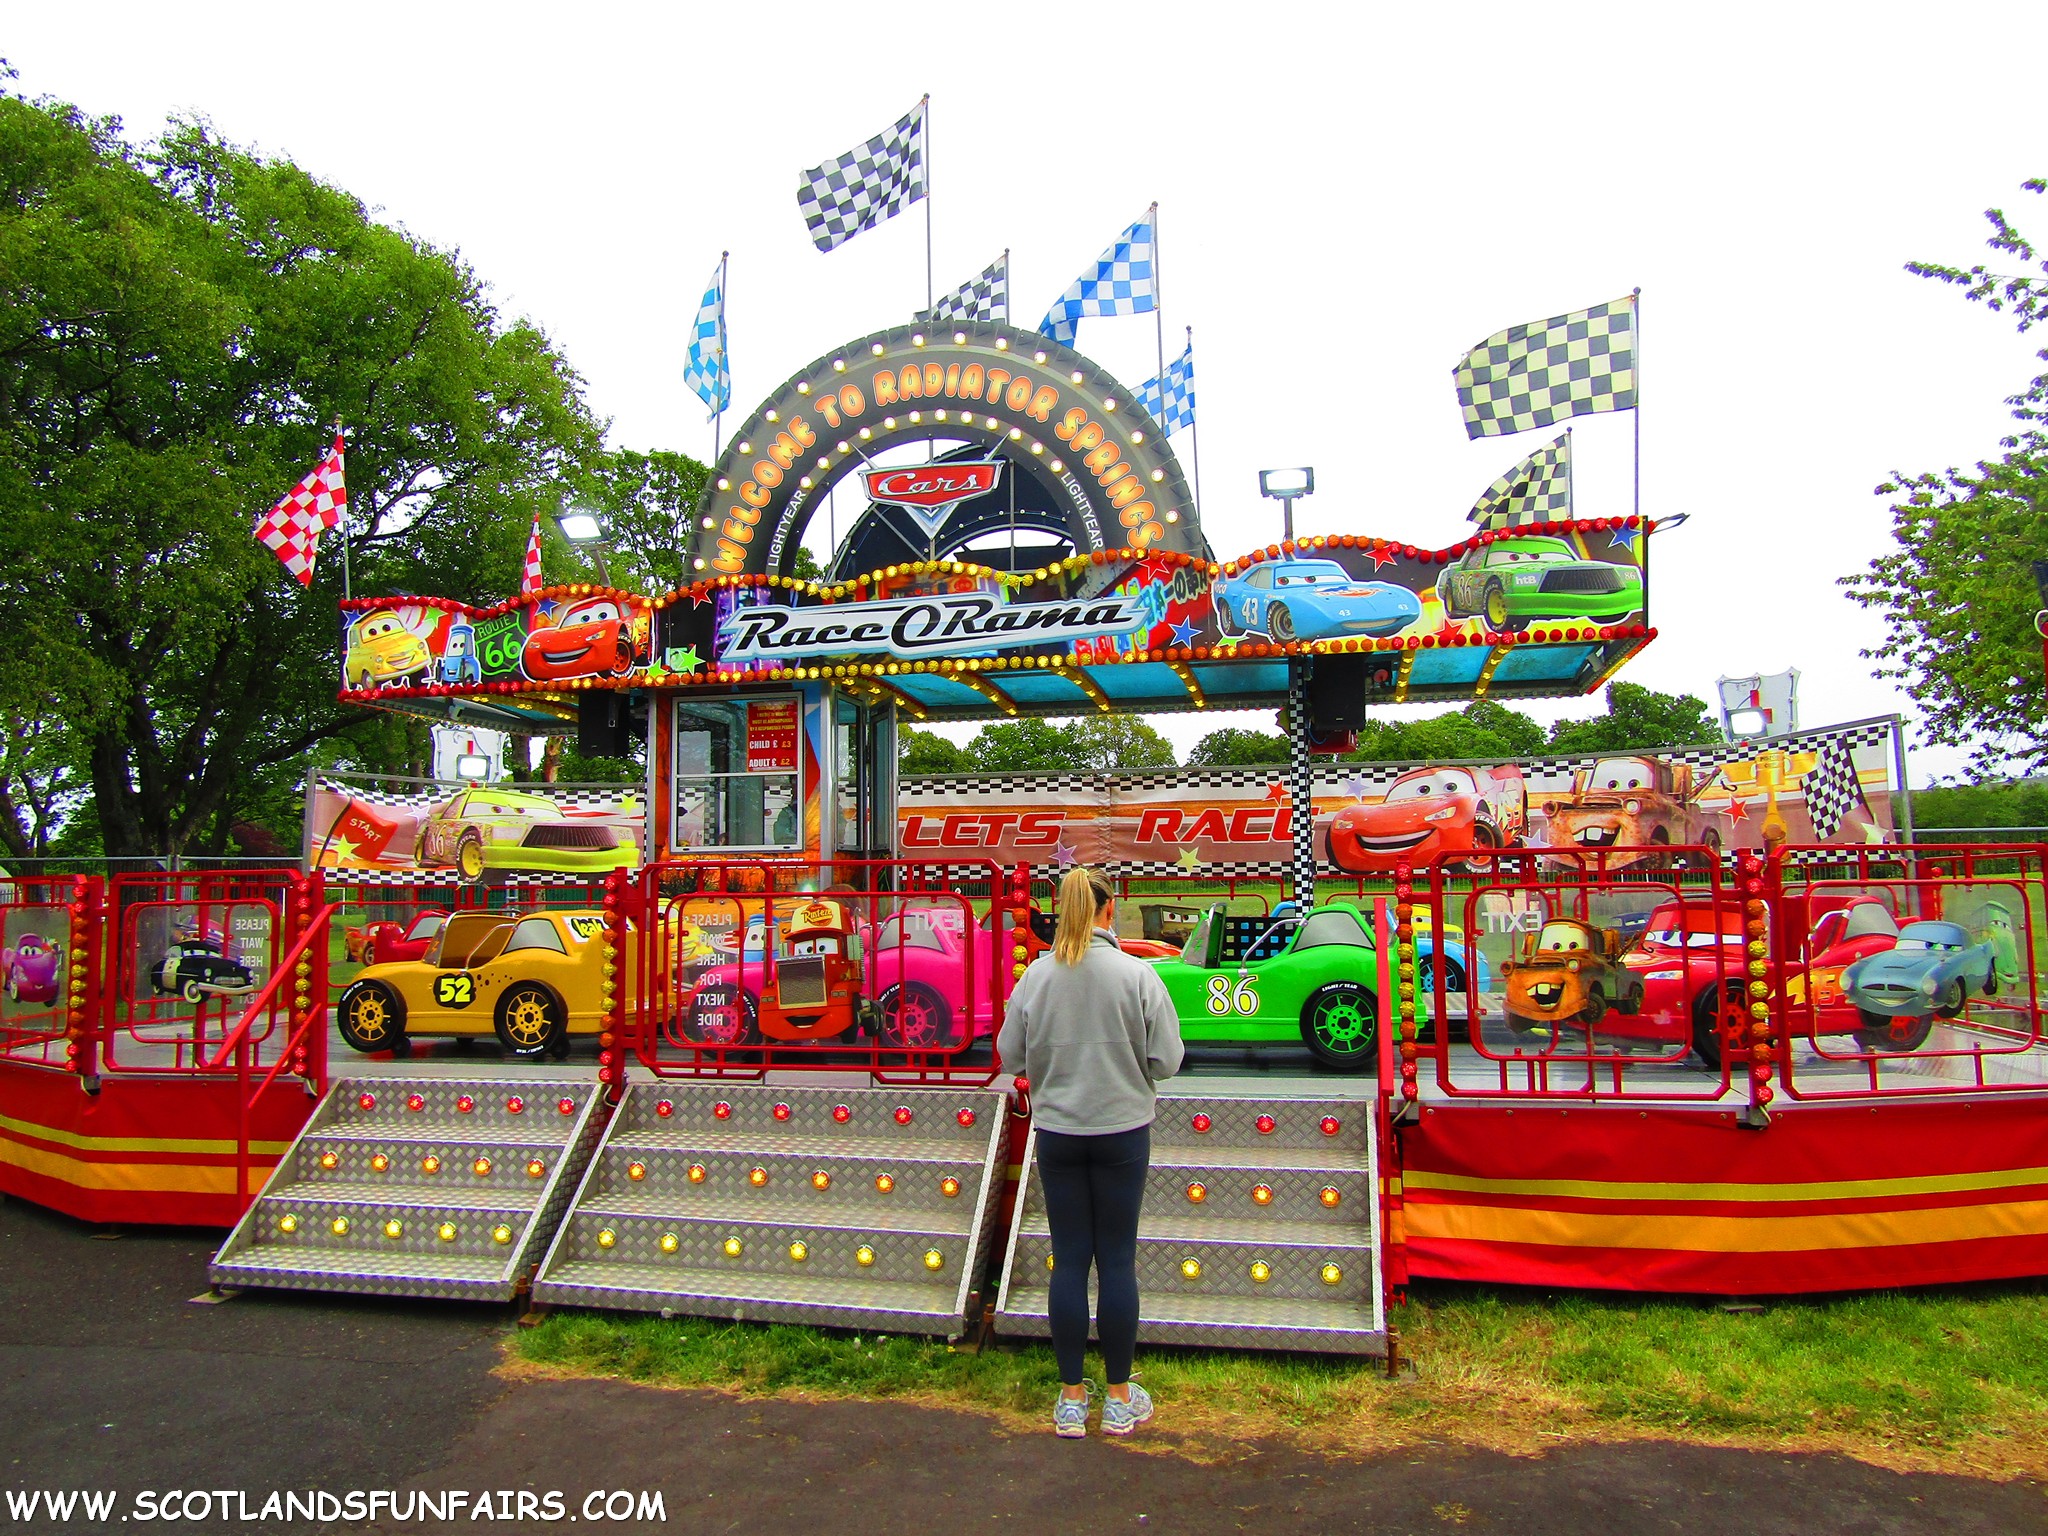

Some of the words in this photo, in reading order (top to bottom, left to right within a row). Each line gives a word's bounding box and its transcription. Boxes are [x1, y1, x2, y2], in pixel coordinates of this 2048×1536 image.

[711, 415, 817, 573] WELCOME
[814, 384, 866, 429] TO
[873, 362, 1060, 423] RADIATOR
[1054, 407, 1168, 552] SPRINGS
[878, 472, 982, 495] Cars
[1060, 472, 1104, 549] LIGHTYEAR
[768, 490, 806, 567] LIGHTYEAR
[1458, 573, 1473, 608] 86
[1241, 597, 1260, 626] 43
[1338, 609, 1352, 617] 43
[477, 617, 511, 639] ROUTE
[485, 632, 522, 668] 66
[749, 740, 770, 750] CHILD
[781, 740, 792, 748] £3
[749, 758, 771, 768] ADULT
[780, 758, 791, 766] £2
[349, 818, 382, 842] START
[901, 812, 1068, 849] LETS
[440, 976, 471, 1003] 52
[1206, 974, 1260, 1017] 86
